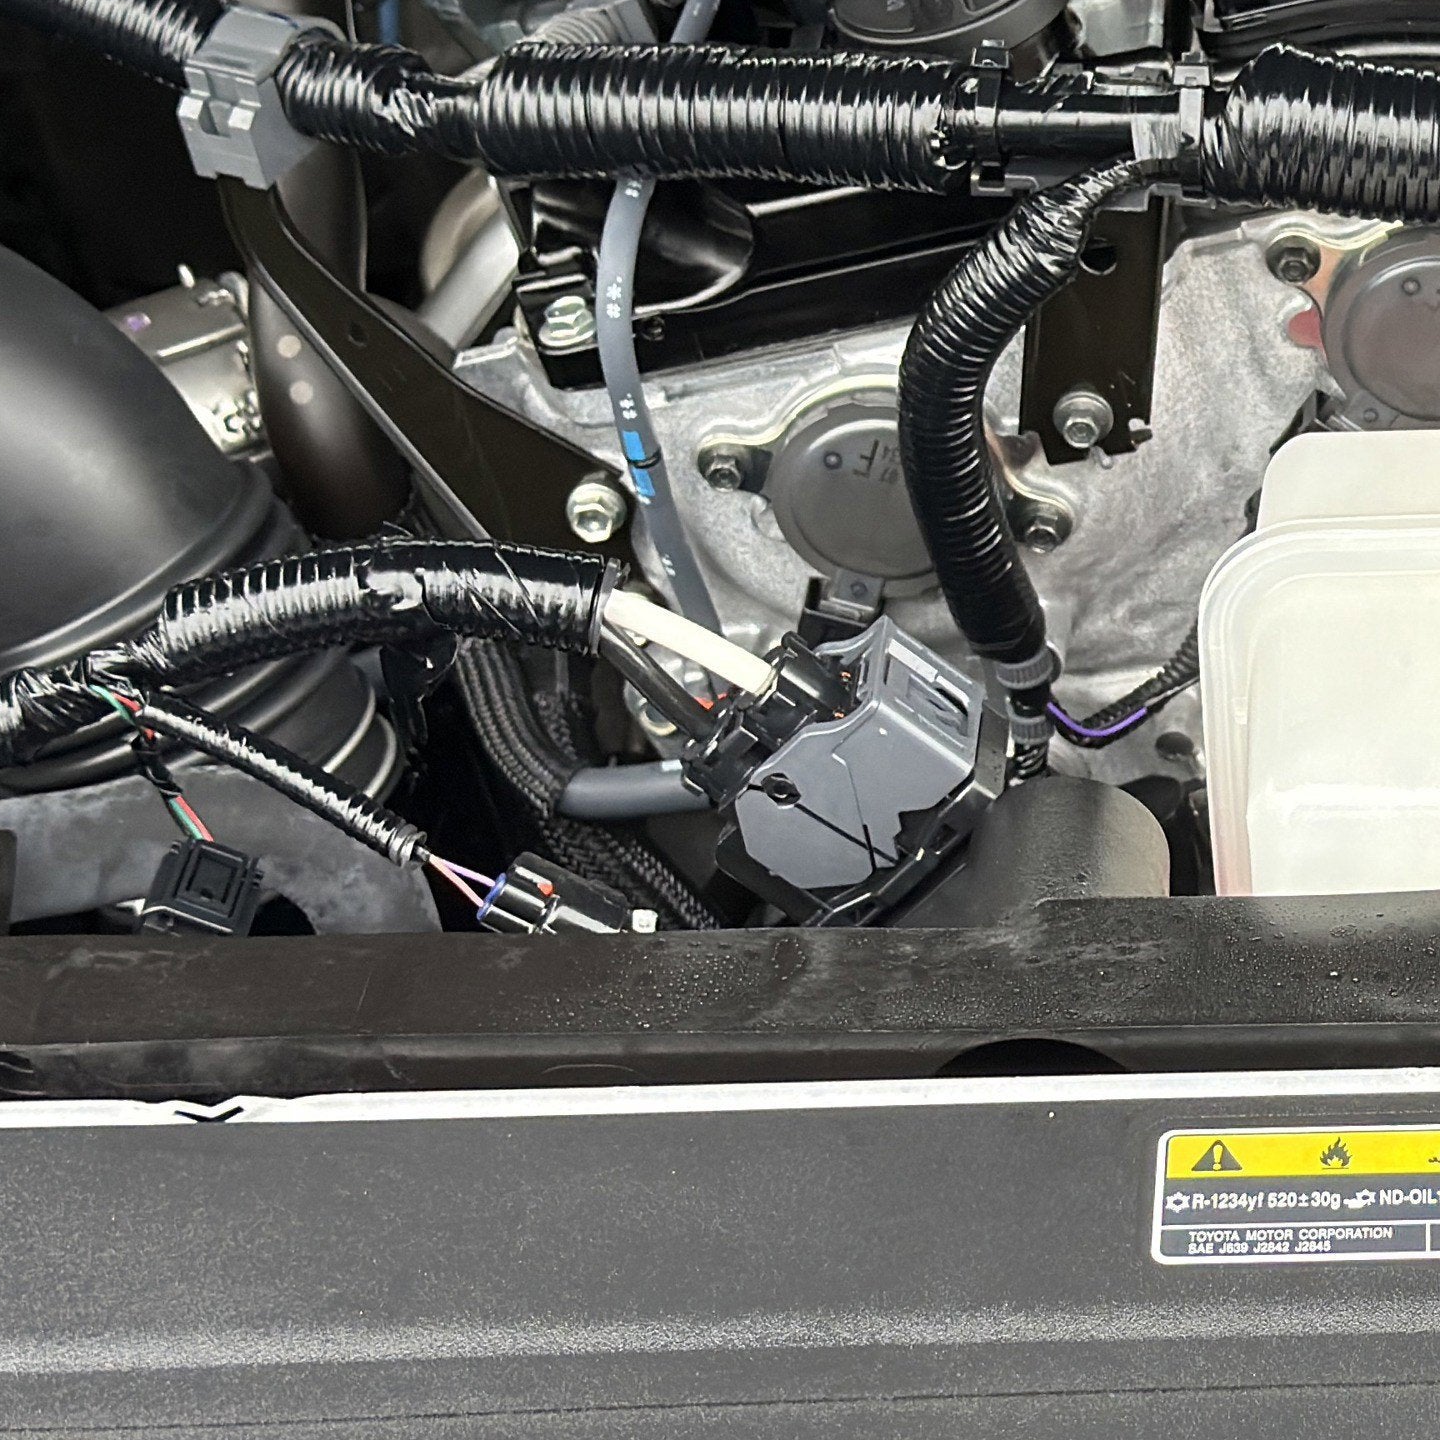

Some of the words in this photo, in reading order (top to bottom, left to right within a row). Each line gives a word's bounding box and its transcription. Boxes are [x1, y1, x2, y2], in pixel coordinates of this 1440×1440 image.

[1191, 1191, 1264, 1212] R-1234yf
[1267, 1190, 1342, 1211] 520±30g
[1188, 1230, 1241, 1243] TOYOTA
[1245, 1229, 1294, 1242] MOTOR
[1298, 1226, 1394, 1241] CORPORATION
[1188, 1242, 1214, 1255] SAE
[1253, 1241, 1290, 1254] J2842
[1294, 1240, 1332, 1253] J2845
